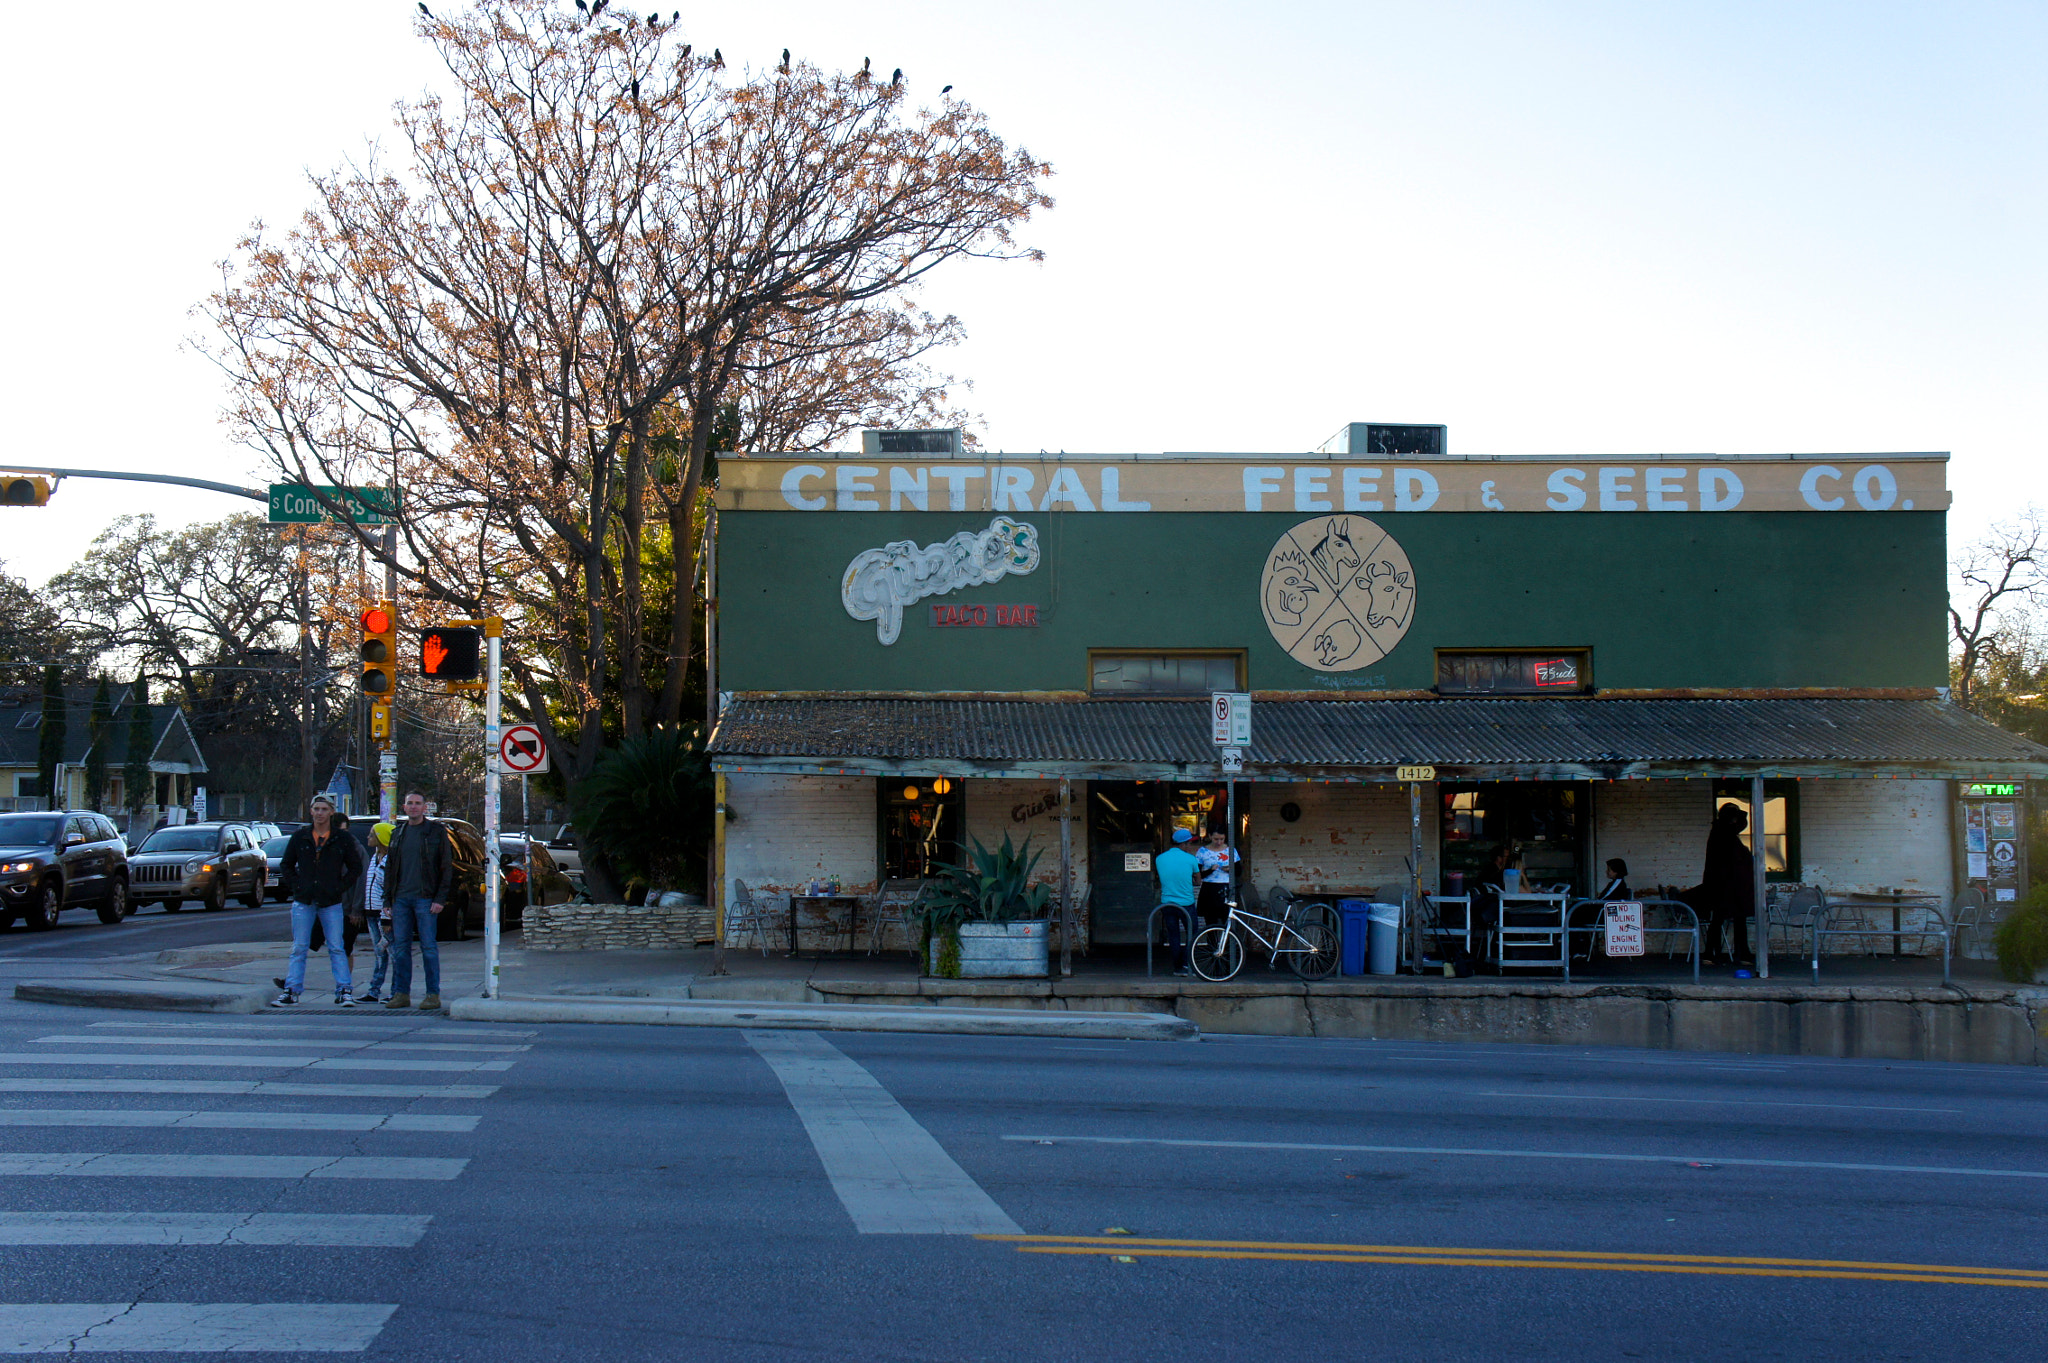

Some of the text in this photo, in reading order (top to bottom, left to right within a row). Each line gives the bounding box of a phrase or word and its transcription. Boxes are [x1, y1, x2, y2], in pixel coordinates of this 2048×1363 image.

[780, 465, 1914, 512] CENTRAL FEED & SEED CO.
[272, 497, 280, 510] S
[932, 604, 1038, 627] TACO BAR
[1400, 768, 1431, 779] 1412
[1610, 945, 1640, 953] REVVING
